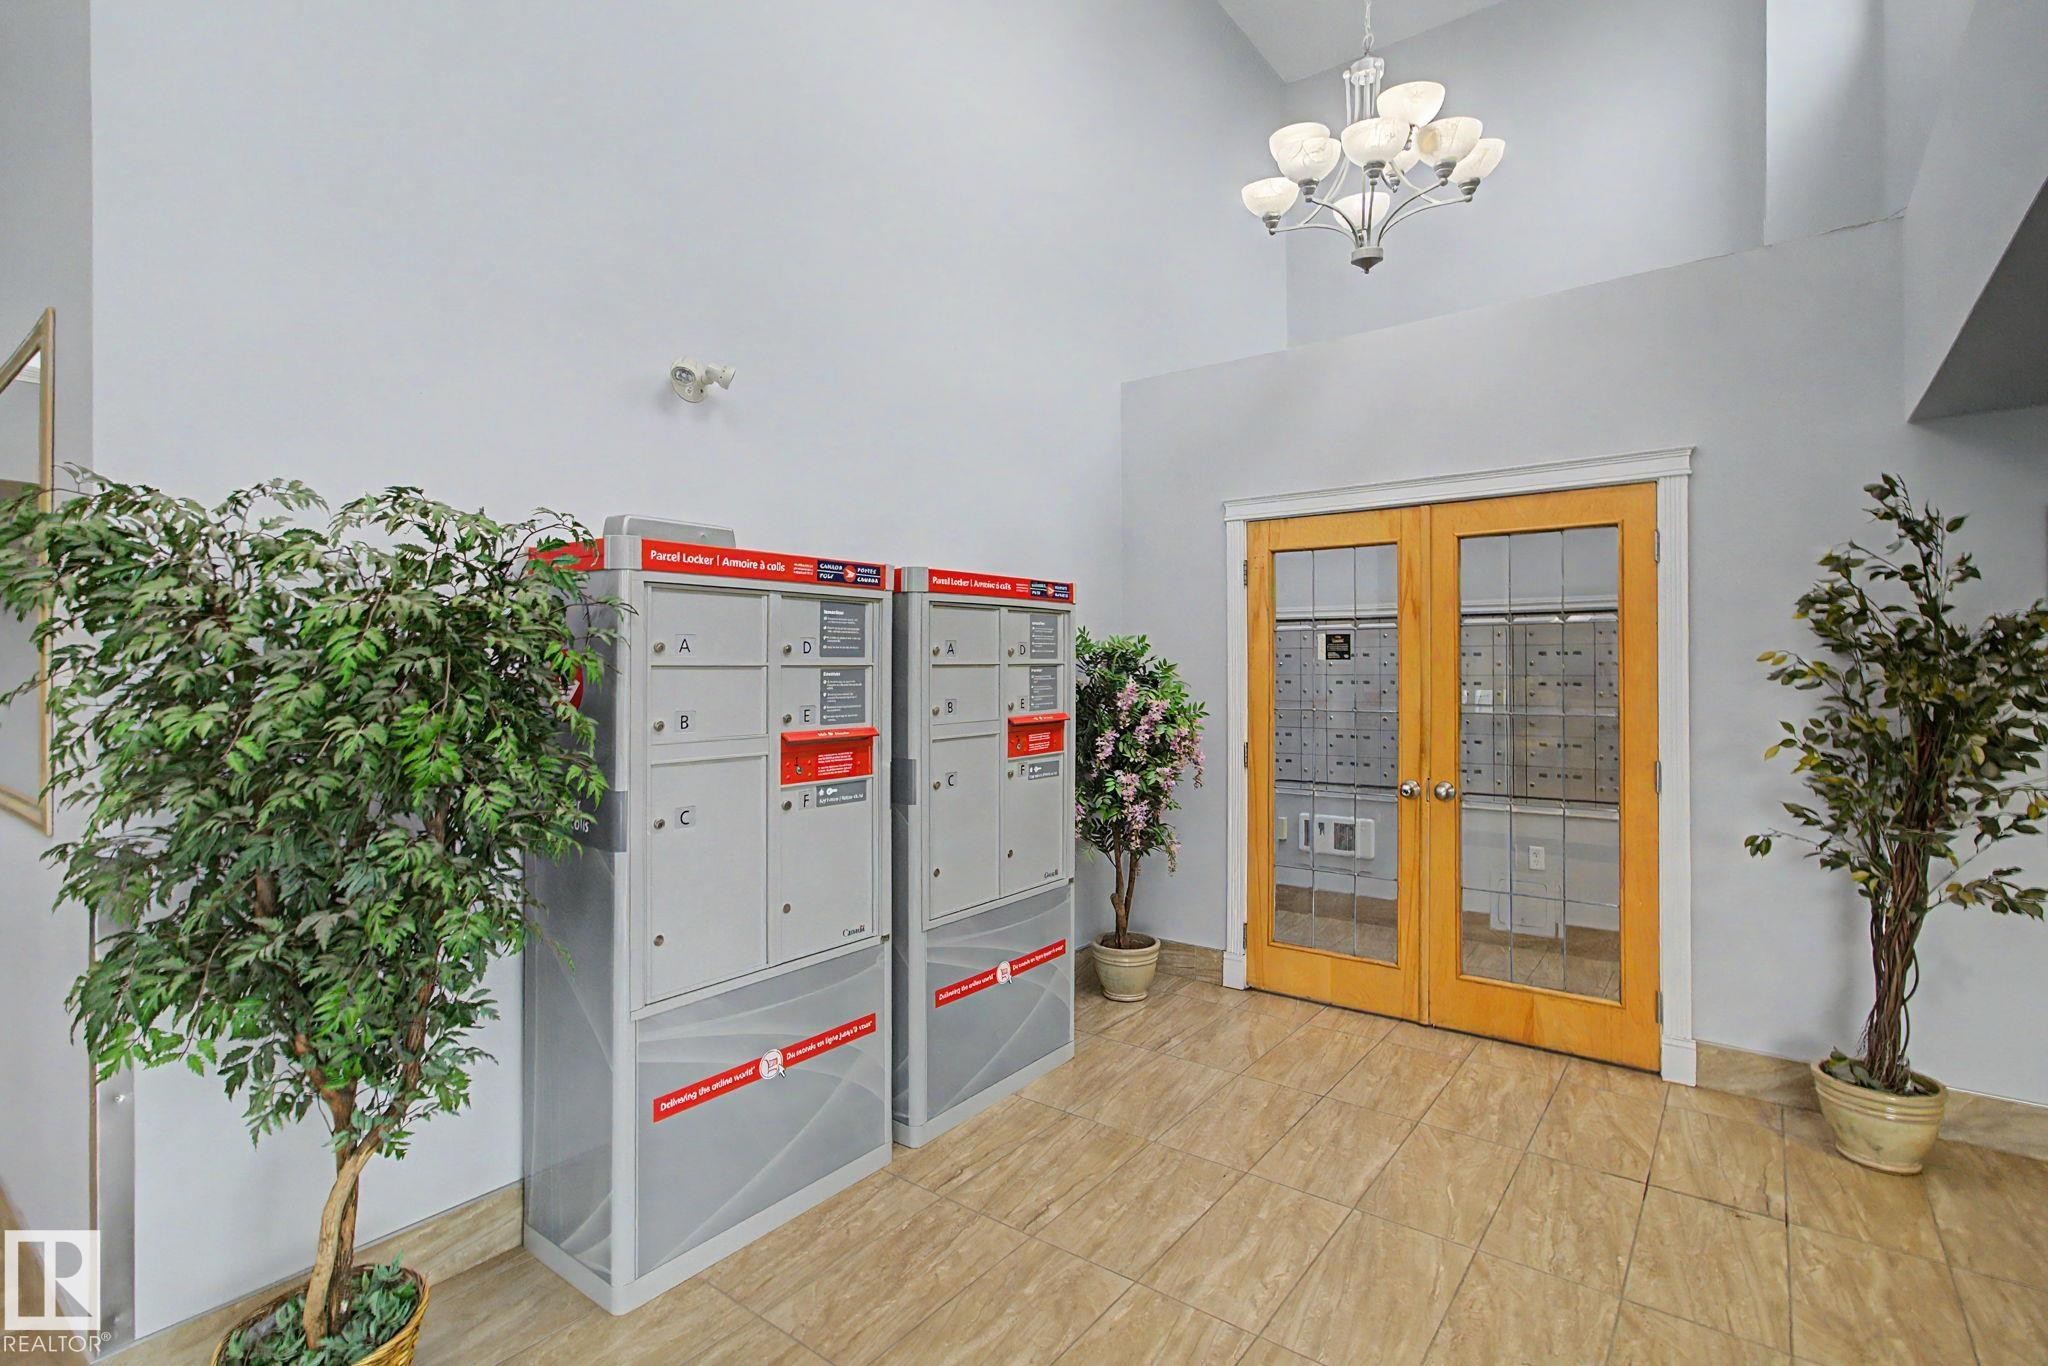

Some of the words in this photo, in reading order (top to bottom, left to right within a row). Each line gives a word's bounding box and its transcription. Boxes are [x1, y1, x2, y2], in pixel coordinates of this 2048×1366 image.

[650, 549, 680, 563] Parcel
[683, 552, 714, 566] Locker
[722, 556, 758, 570] Armoire
[759, 560, 765, 570] à
[766, 561, 786, 572] colis
[678, 638, 691, 653] A
[803, 641, 812, 654] D
[946, 643, 955, 655] A
[1019, 644, 1026, 655] D
[947, 701, 953, 714] B
[1020, 698, 1025, 709] E
[680, 714, 689, 730] B
[803, 708, 811, 723] E
[1020, 764, 1025, 775] F
[947, 774, 955, 787] C
[803, 793, 811, 808] F
[680, 809, 690, 825] C
[786, 1051, 796, 1061] Du
[660, 1091, 698, 1112] Delivering
[698, 1085, 711, 1096] the
[711, 1077, 733, 1091] online
